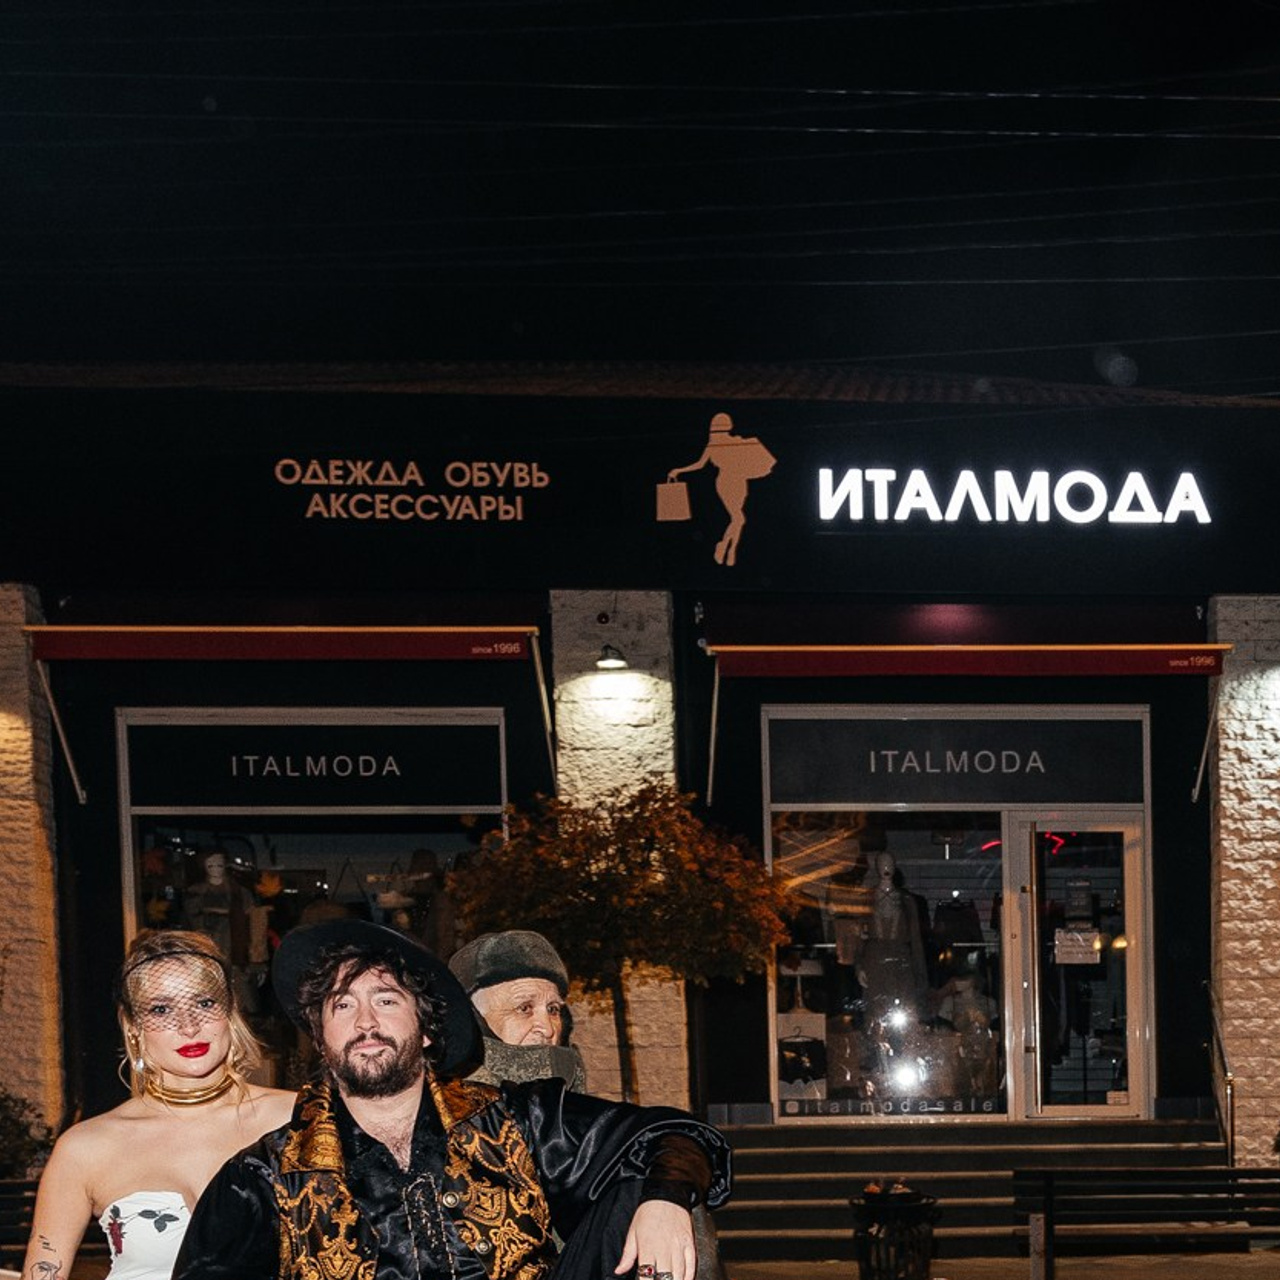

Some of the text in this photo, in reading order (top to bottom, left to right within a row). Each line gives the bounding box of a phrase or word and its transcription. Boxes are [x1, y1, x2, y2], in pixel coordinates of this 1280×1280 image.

[275, 458, 550, 488] ОДЕЖДА ОБУВЬ
[305, 493, 523, 521] АКСЕССУАРЫ
[818, 468, 1212, 526] ИТАЛМОДА
[493, 642, 521, 654] 1996
[1190, 655, 1215, 666] 1996
[231, 755, 401, 777] ITALMODA
[870, 750, 1045, 773] ITALMODA
